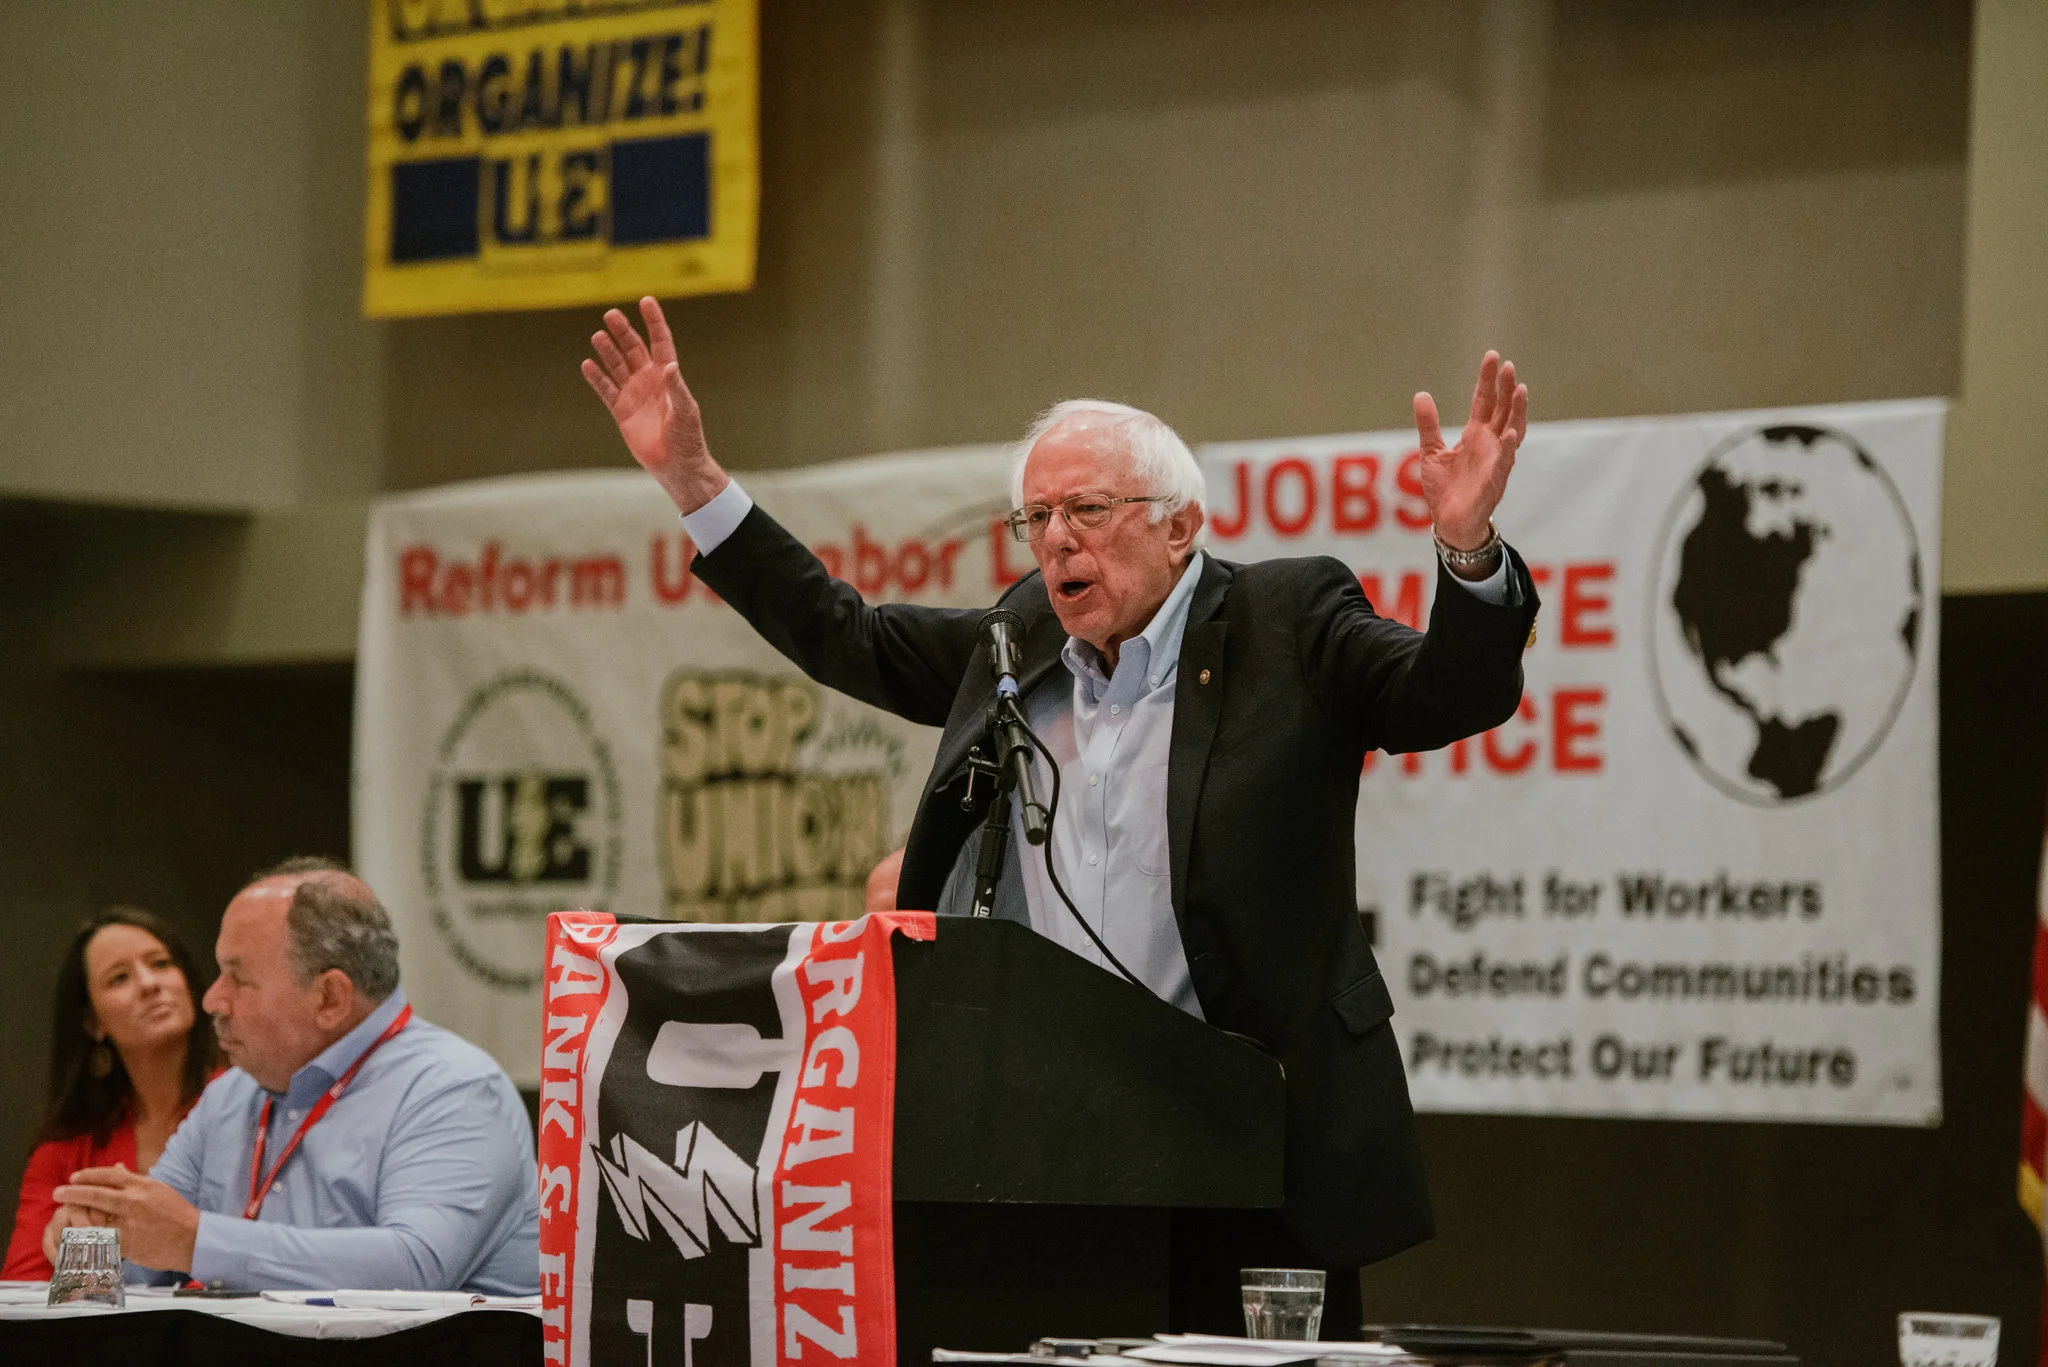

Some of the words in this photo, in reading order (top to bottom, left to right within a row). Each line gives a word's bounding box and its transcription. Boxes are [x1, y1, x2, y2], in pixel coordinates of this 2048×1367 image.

[396, 23, 712, 142] ORGANIZE!
[1207, 446, 1434, 541] JOBS
[400, 538, 625, 614] Reform
[811, 521, 966, 597] abor
[664, 674, 818, 782] STOP
[455, 772, 592, 882] UE
[665, 778, 888, 893] UNION
[1409, 871, 1526, 931] Fight
[1542, 869, 1604, 919] for
[1616, 868, 1824, 920] Workers
[1408, 952, 1569, 1000] Defend
[1581, 951, 1918, 1006] Communities
[1409, 1033, 1575, 1082] Protect
[1589, 1032, 1686, 1083] Our
[1699, 1035, 1859, 1088] Future
